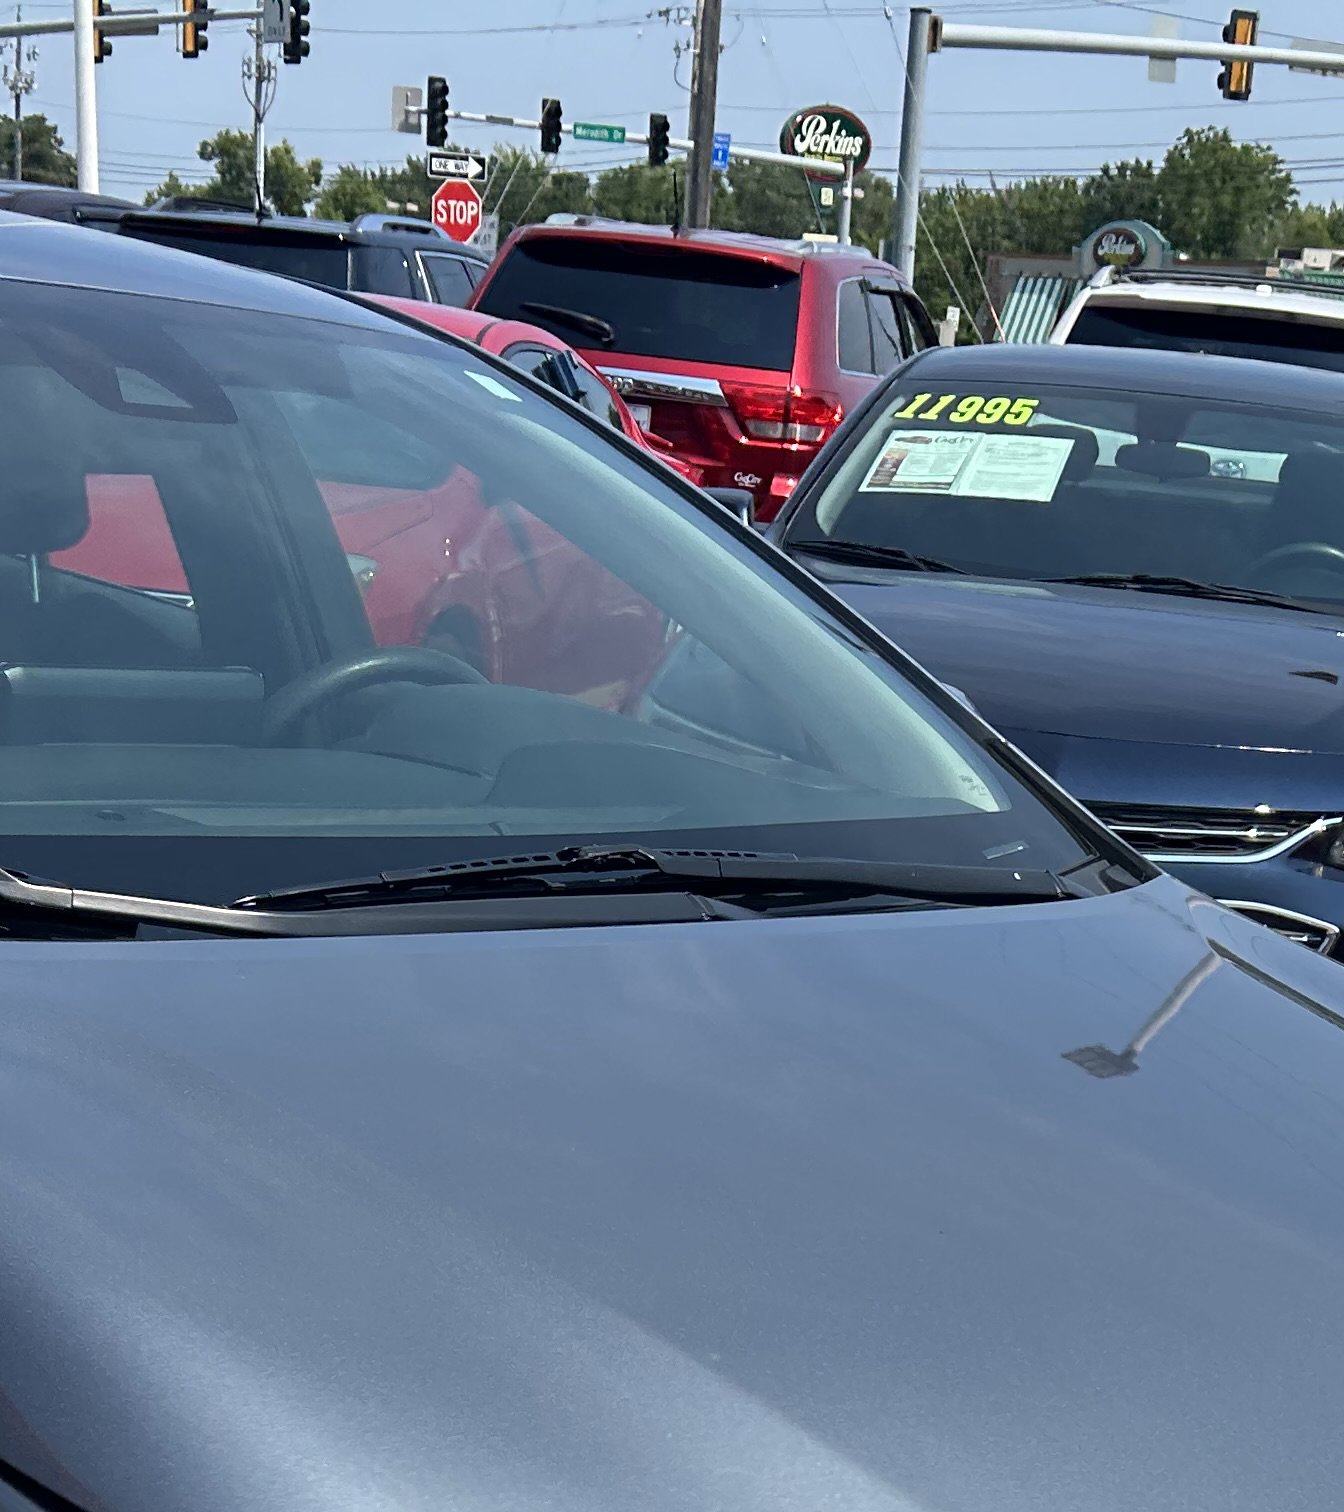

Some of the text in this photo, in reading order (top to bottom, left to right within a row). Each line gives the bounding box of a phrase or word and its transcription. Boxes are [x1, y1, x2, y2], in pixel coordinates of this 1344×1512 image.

[794, 114, 863, 157] Perkins
[436, 159, 449, 169] ONE
[437, 200, 478, 225] STOP
[894, 393, 1040, 425] 11995
